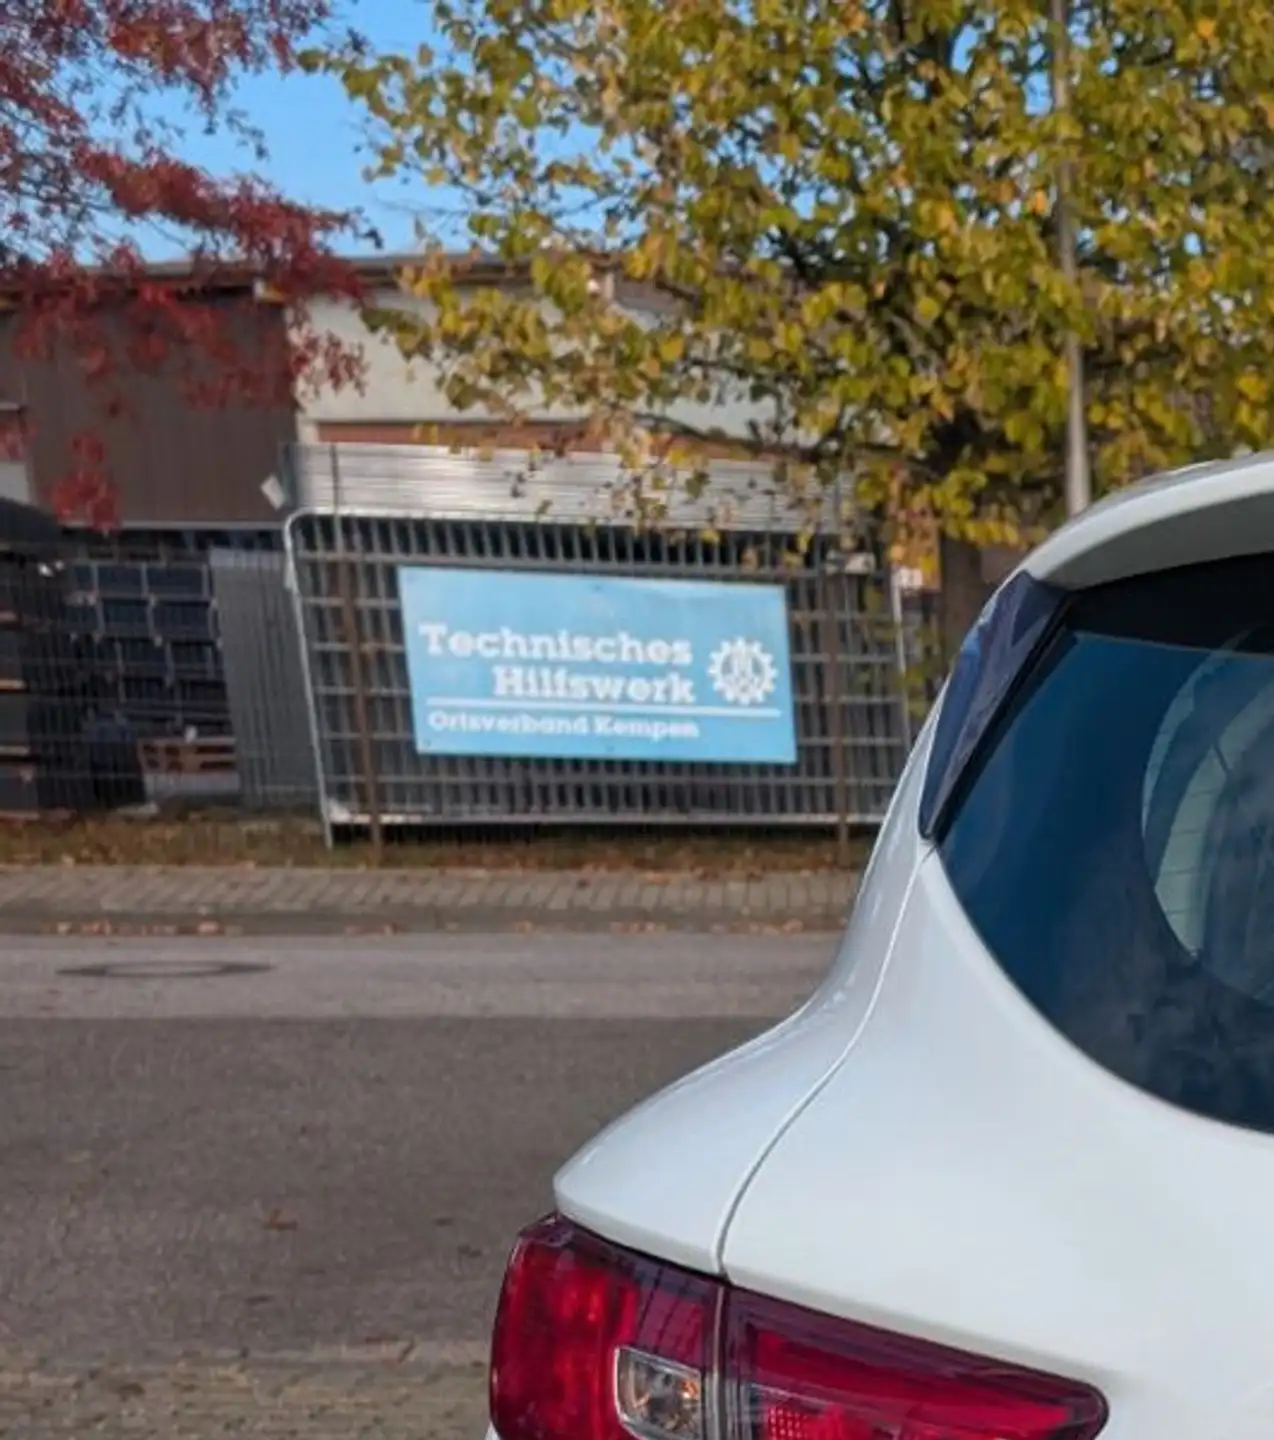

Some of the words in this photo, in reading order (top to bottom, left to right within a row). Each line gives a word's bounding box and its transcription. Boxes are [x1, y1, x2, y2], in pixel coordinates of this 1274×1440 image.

[418, 622, 694, 665] Technisches
[493, 664, 697, 704] Hilfswerk
[428, 710, 590, 736] Ortsverband
[594, 717, 699, 741] Kempen
